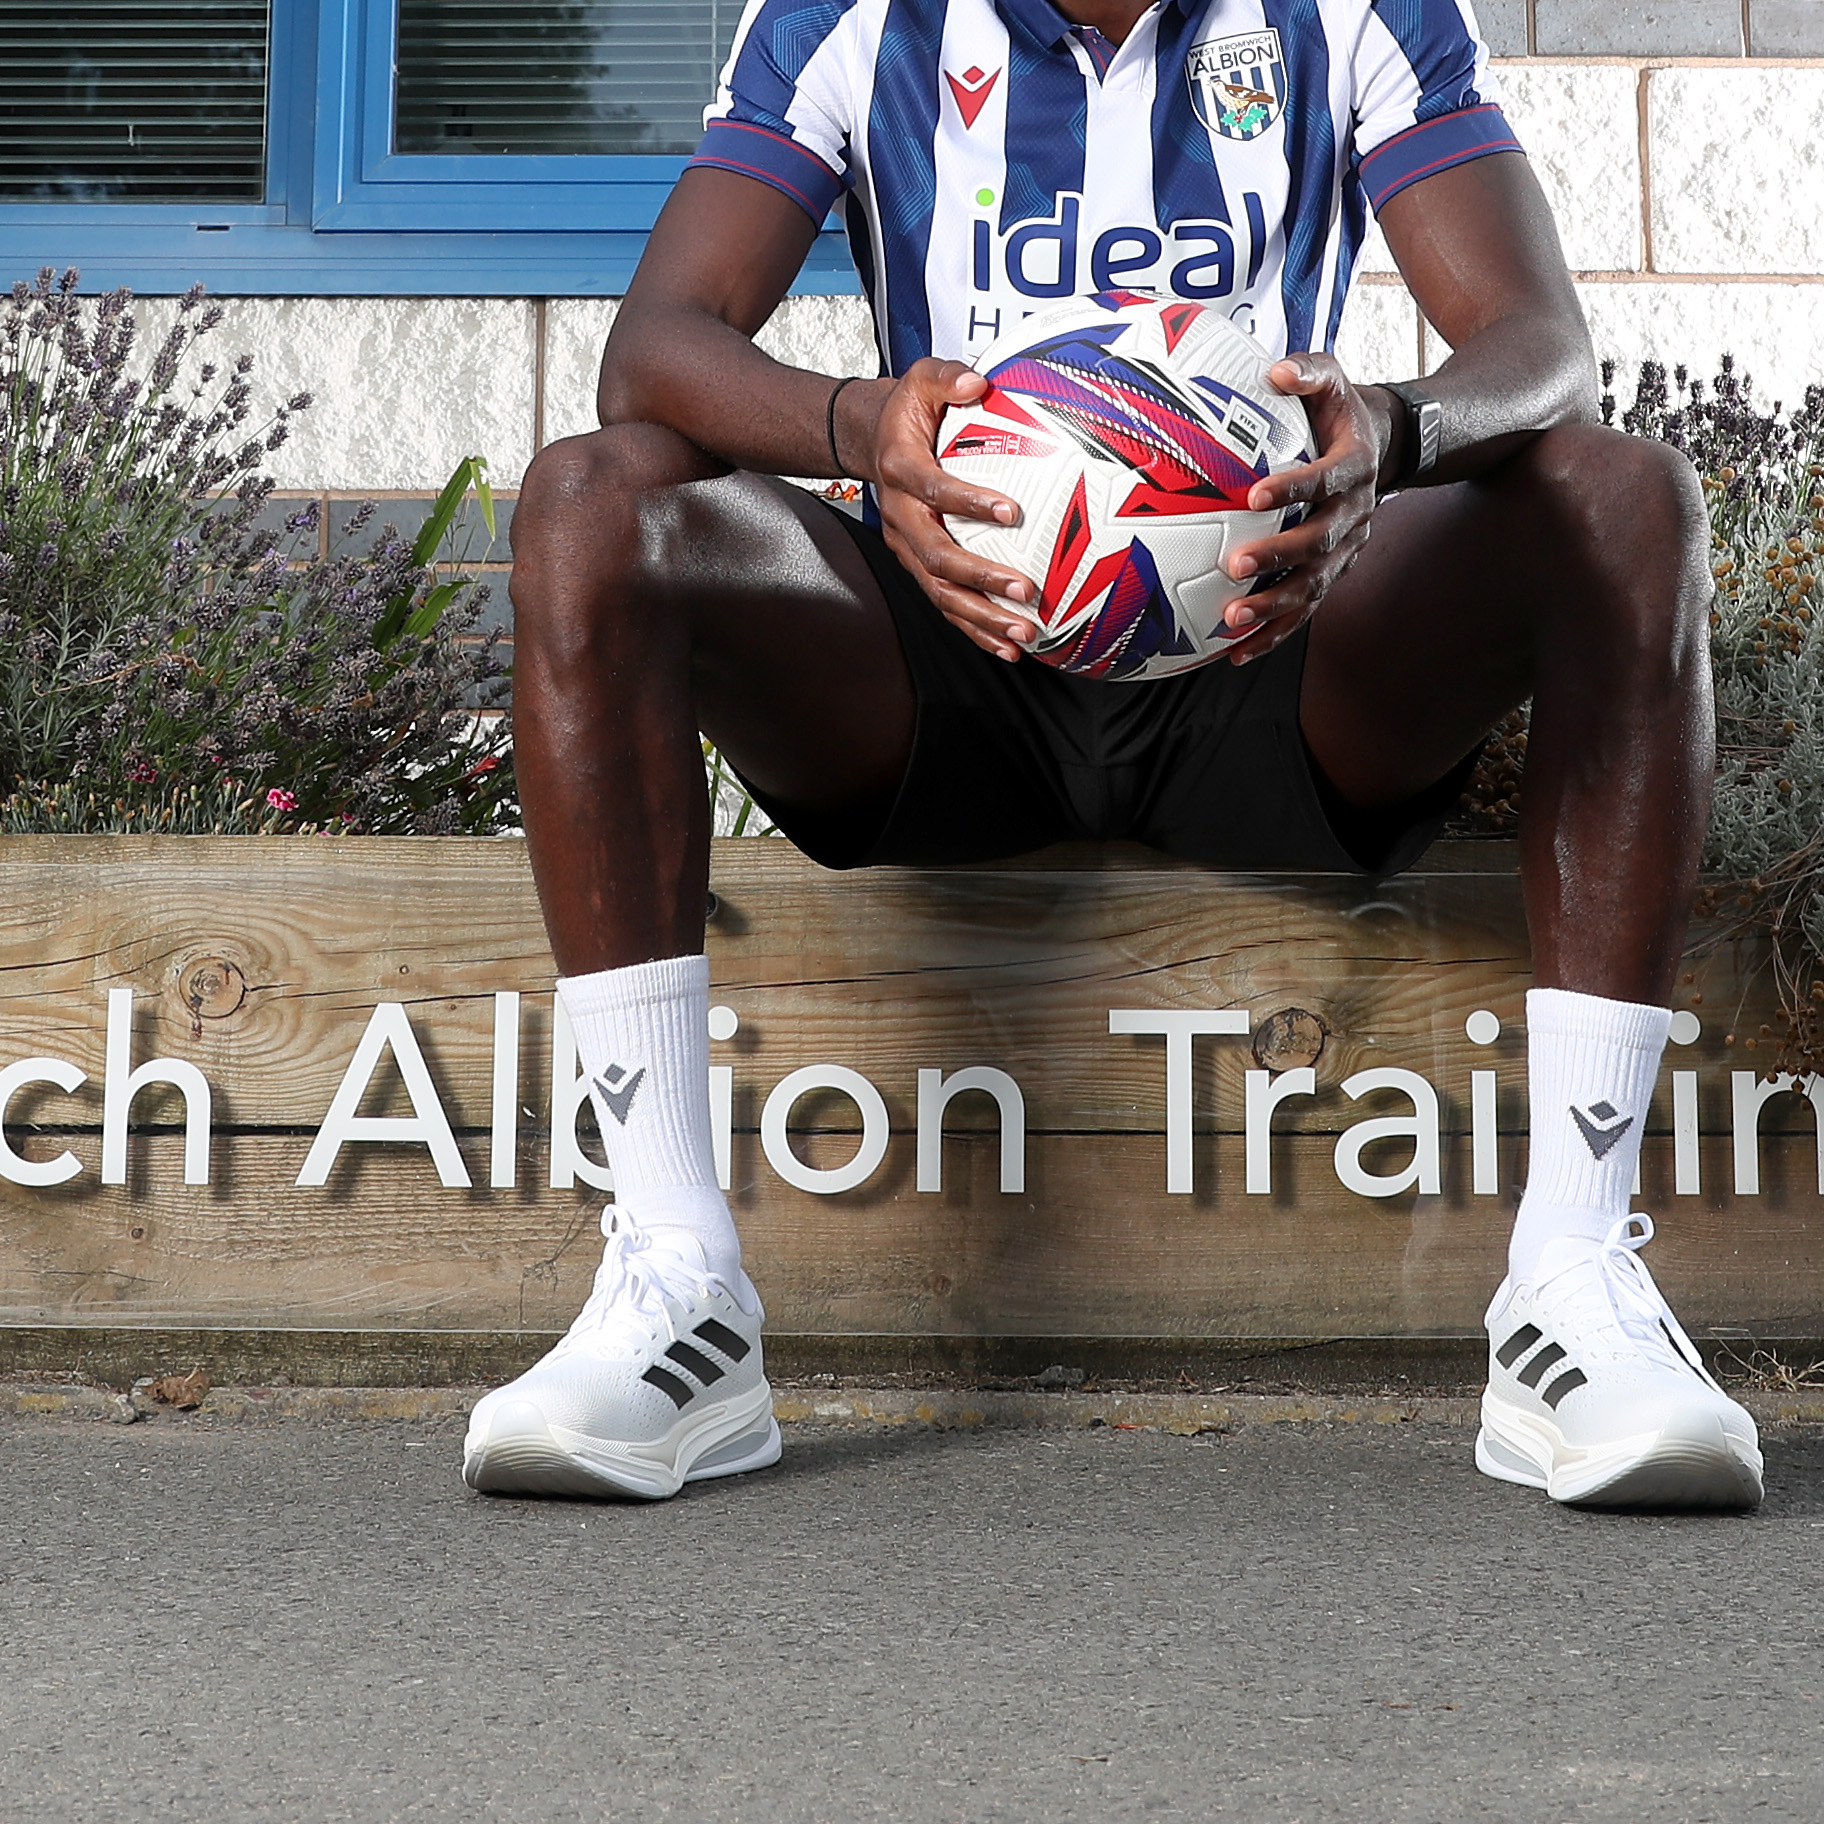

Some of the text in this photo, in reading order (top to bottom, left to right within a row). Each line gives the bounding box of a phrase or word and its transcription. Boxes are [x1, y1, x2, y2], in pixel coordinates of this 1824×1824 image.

[1188, 35, 1271, 60] WEST BROMWICH
[1193, 43, 1274, 76] ALBION
[973, 187, 1267, 299] ideal
[1239, 413, 1257, 431] FIFA
